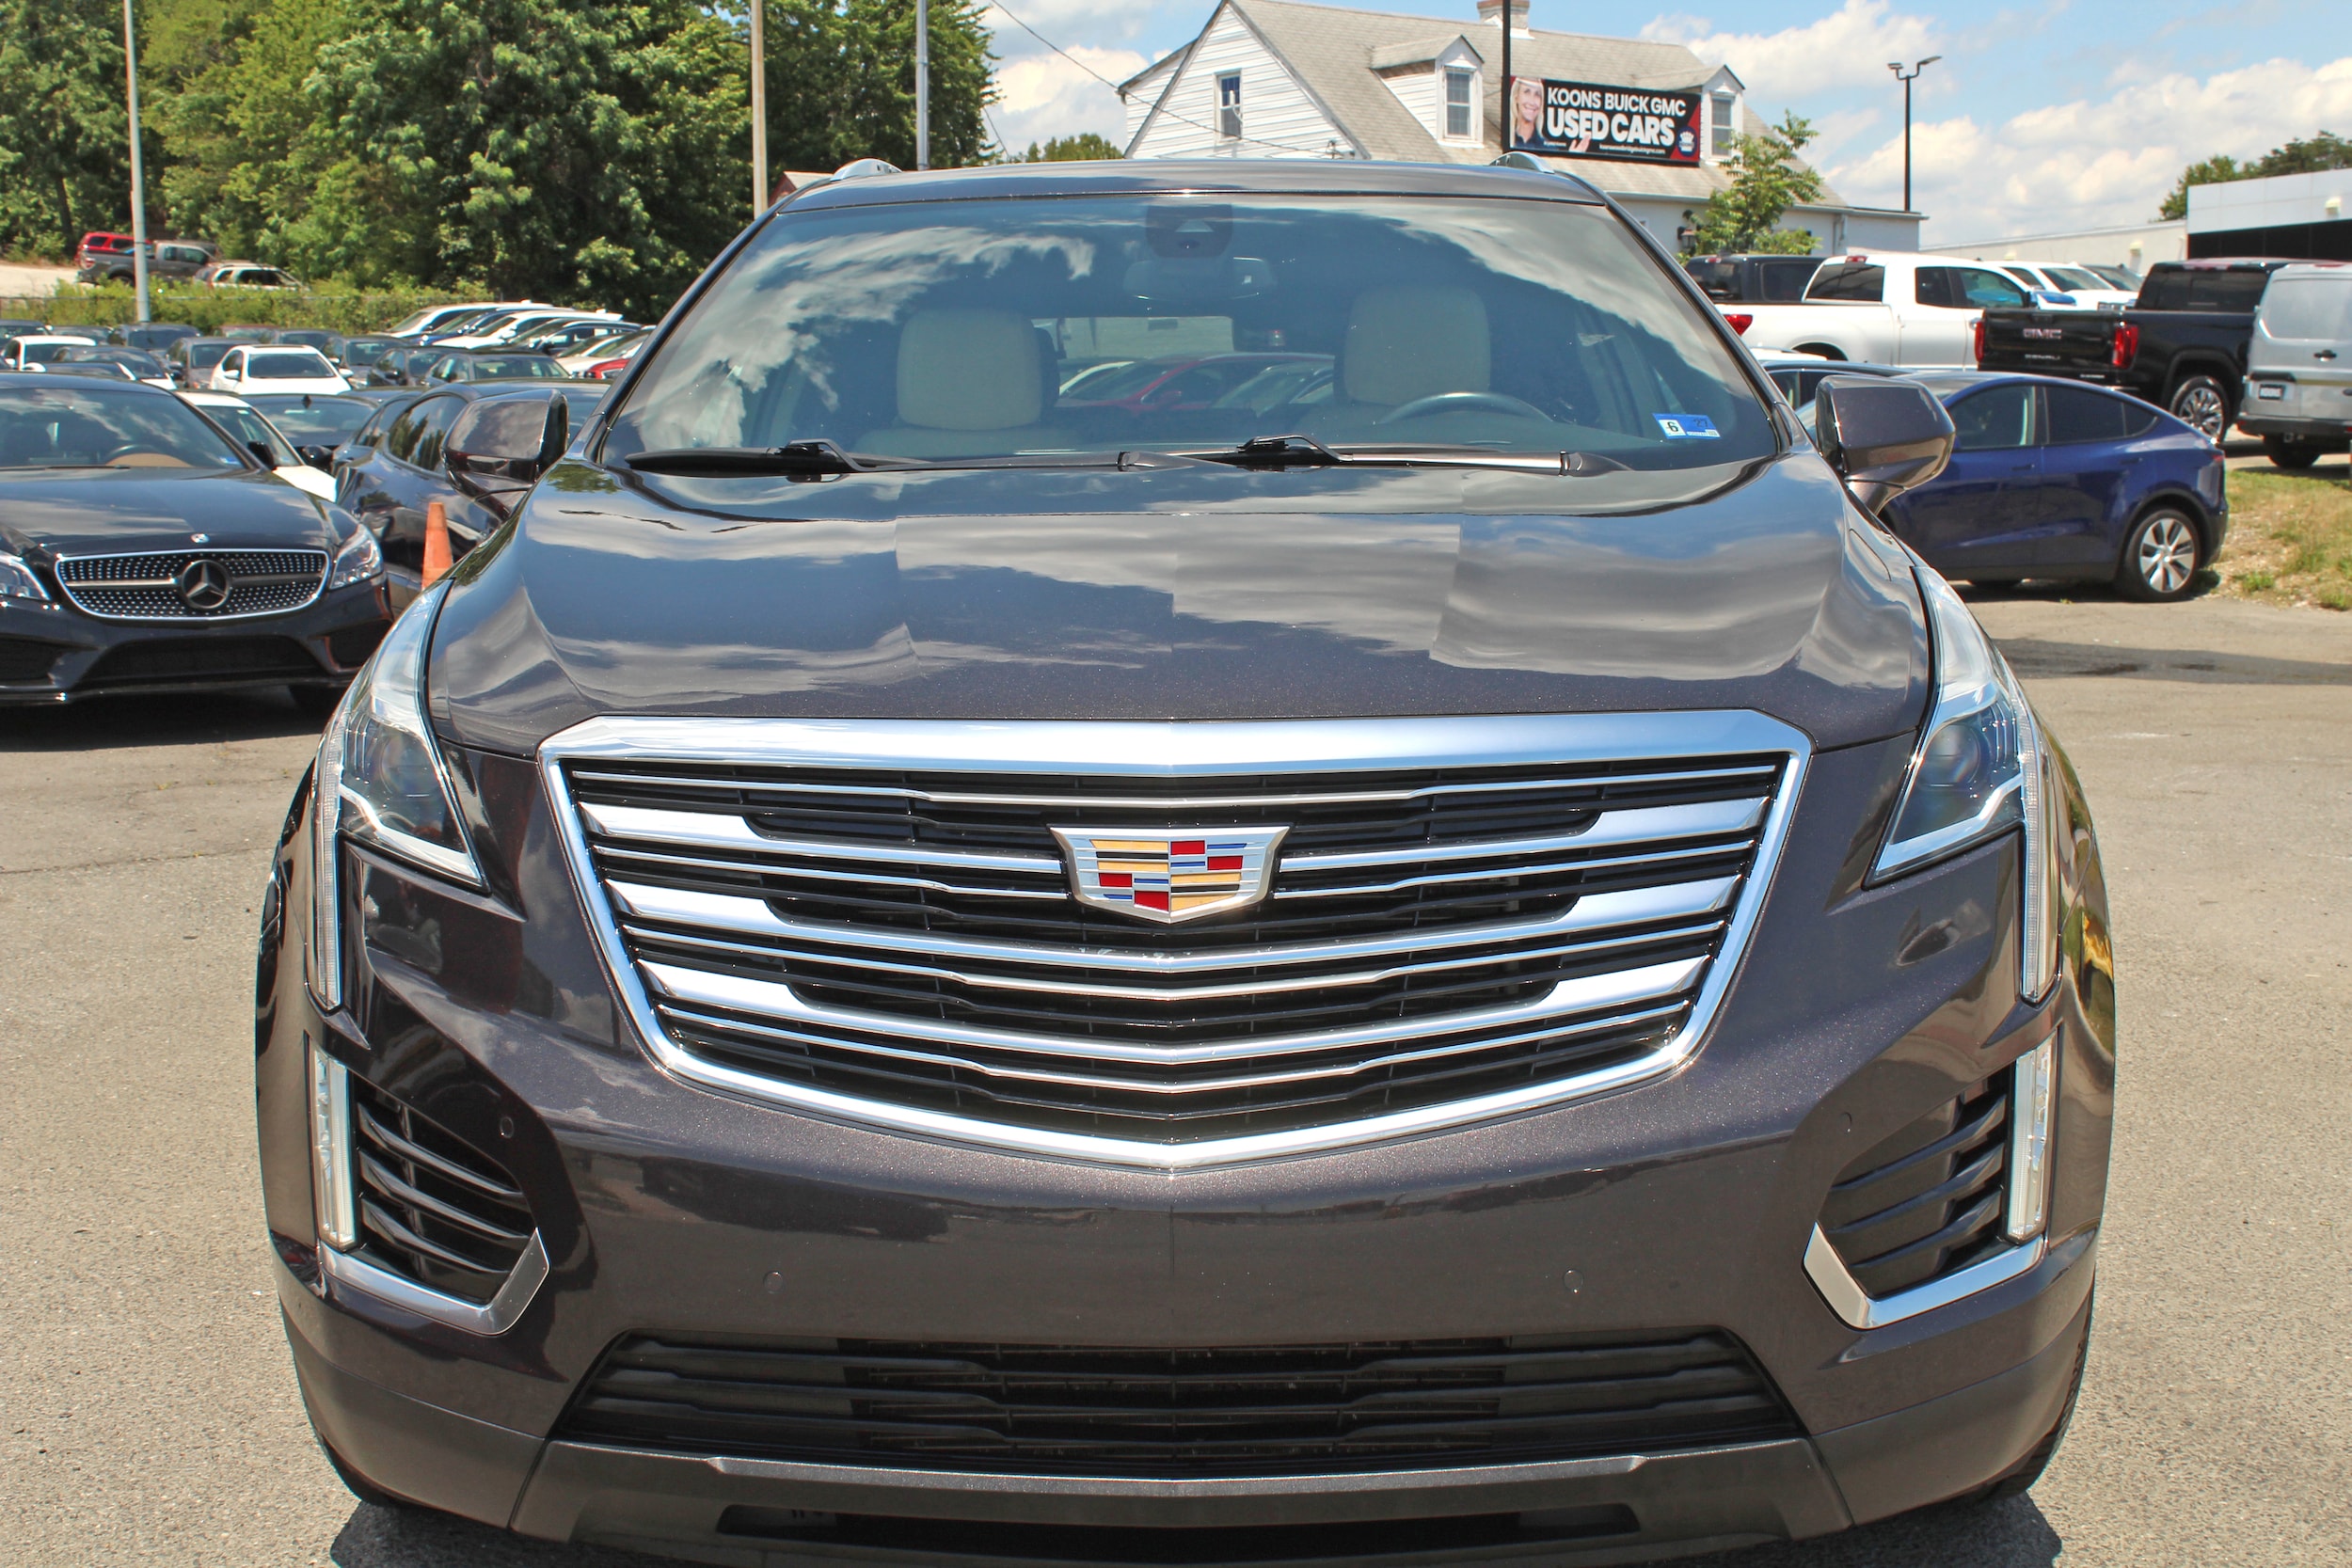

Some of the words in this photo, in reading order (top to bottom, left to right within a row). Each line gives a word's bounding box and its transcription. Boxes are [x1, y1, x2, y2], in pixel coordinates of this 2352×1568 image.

[1548, 87, 1601, 108] KOONS
[1604, 93, 1650, 114] BUICK
[1650, 98, 1686, 117] GMC
[1547, 107, 1610, 140] USED
[1610, 114, 1675, 146] CARS
[2023, 328, 2062, 340] GMC
[1666, 420, 1679, 433] 6
